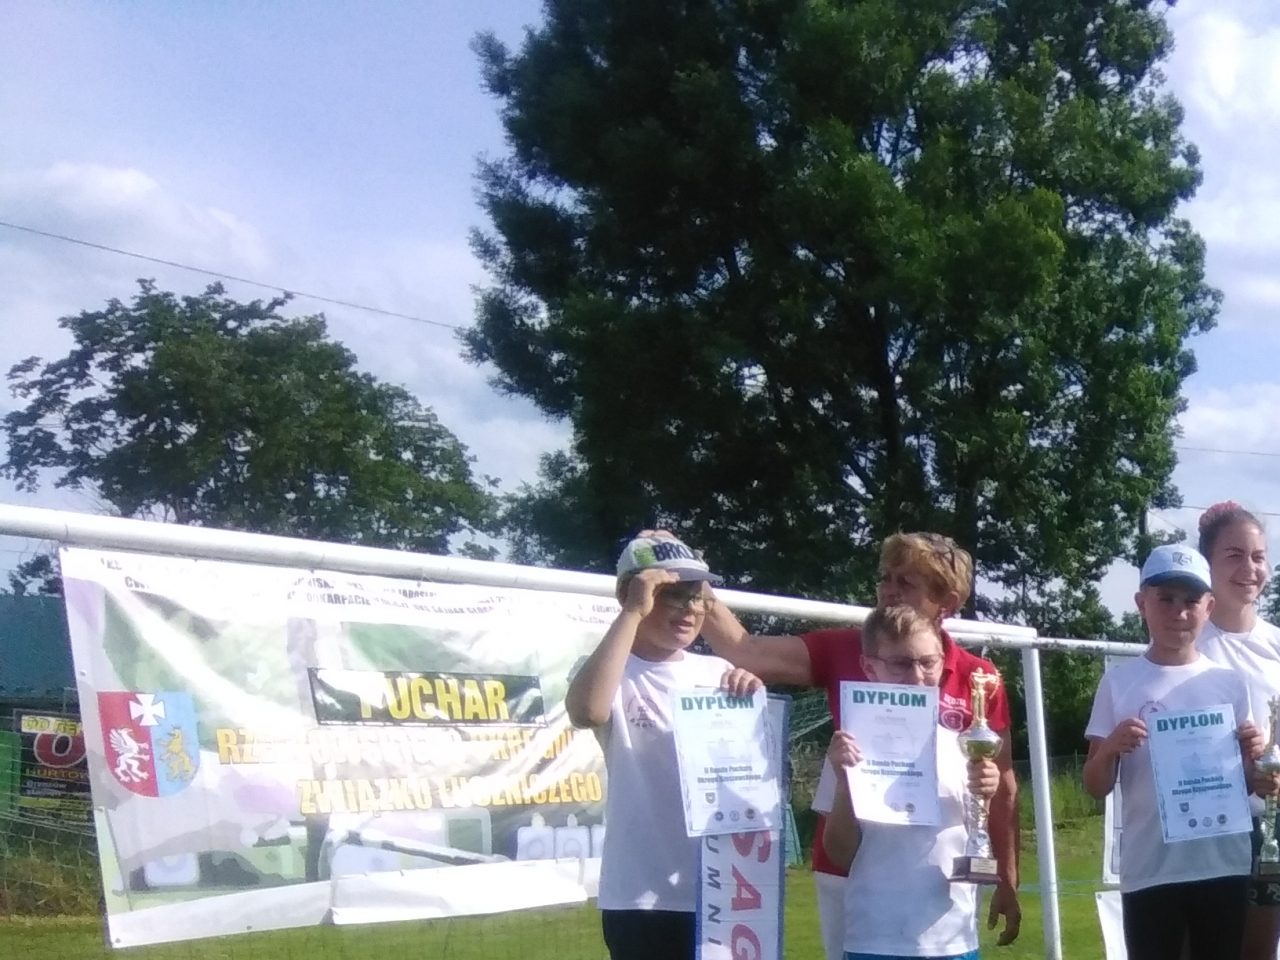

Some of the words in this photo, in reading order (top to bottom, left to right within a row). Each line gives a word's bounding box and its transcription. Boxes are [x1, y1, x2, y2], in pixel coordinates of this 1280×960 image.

[680, 693, 755, 711] DYPLOM
[853, 689, 927, 708] DYPLOM
[1156, 712, 1224, 732] DYPLOM
